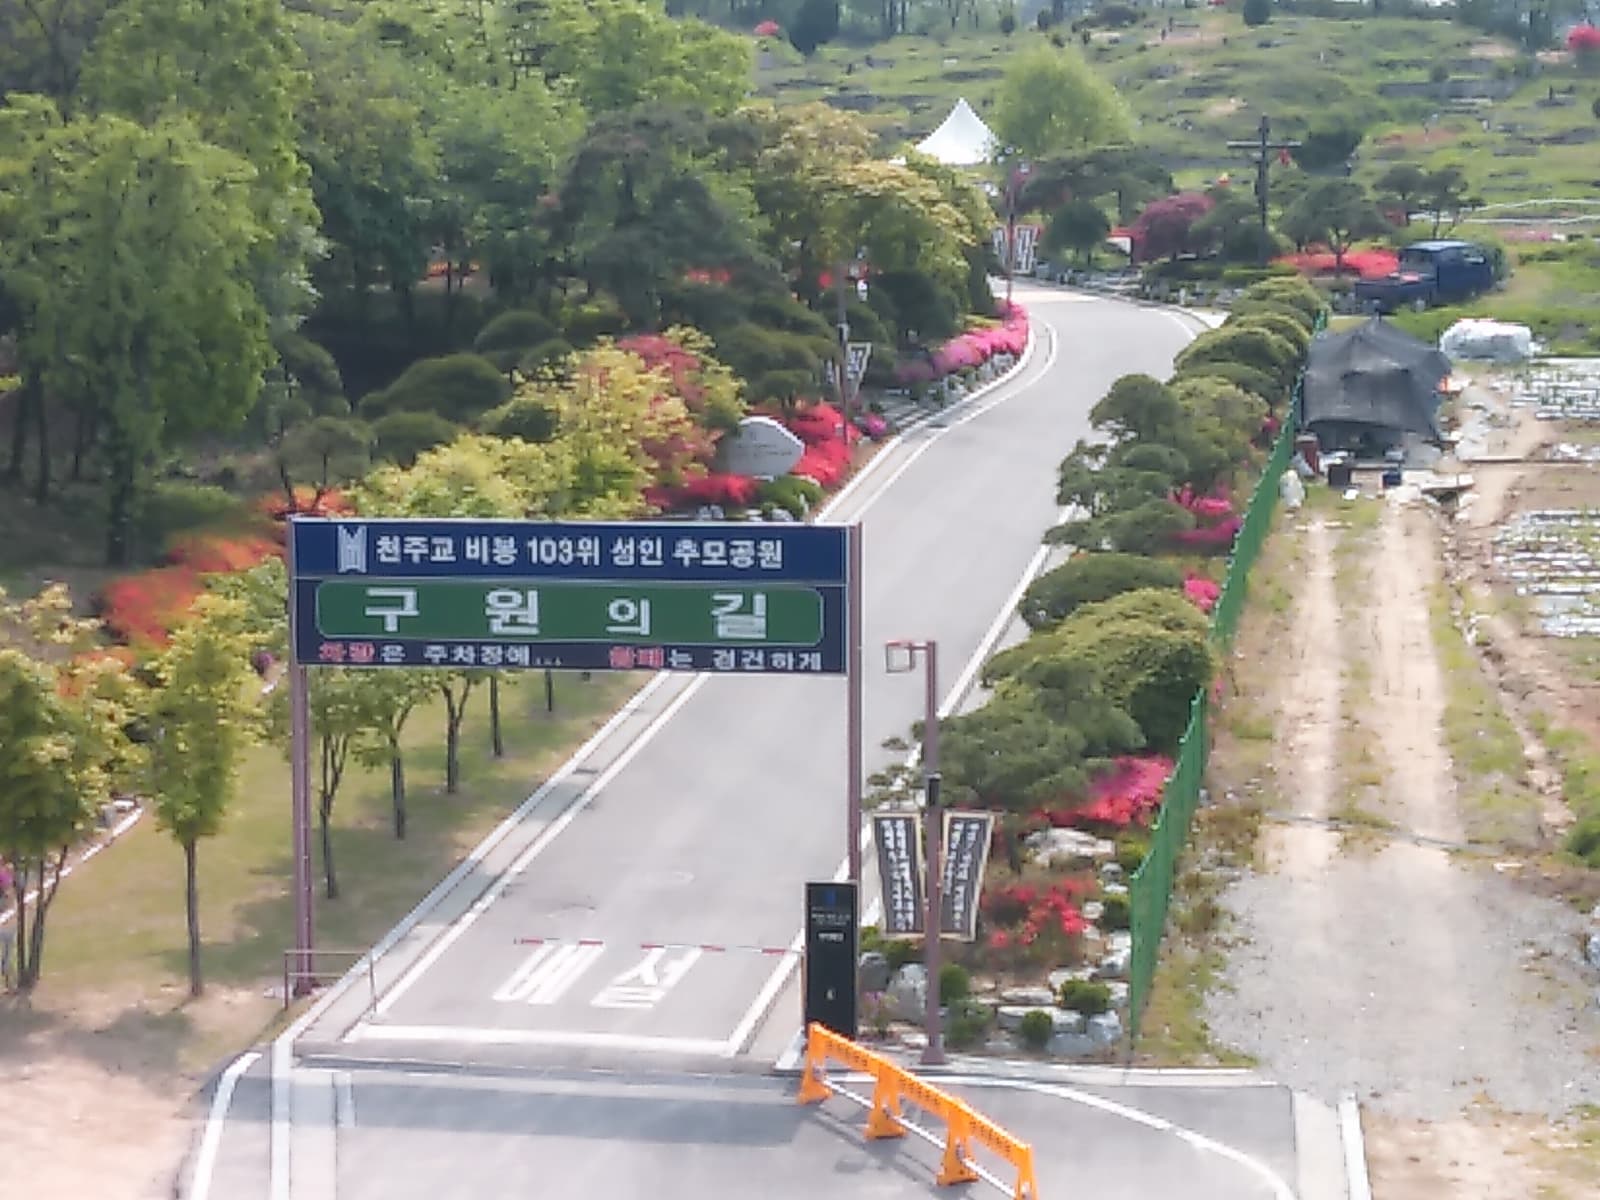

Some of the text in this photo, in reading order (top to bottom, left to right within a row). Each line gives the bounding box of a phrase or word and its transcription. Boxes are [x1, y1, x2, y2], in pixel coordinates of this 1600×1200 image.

[375, 534, 783, 570] 천주교 비봉 103위 성인 추모공원
[365, 586, 767, 640] 구 원 의 길
[712, 648, 822, 672] 경건하게
